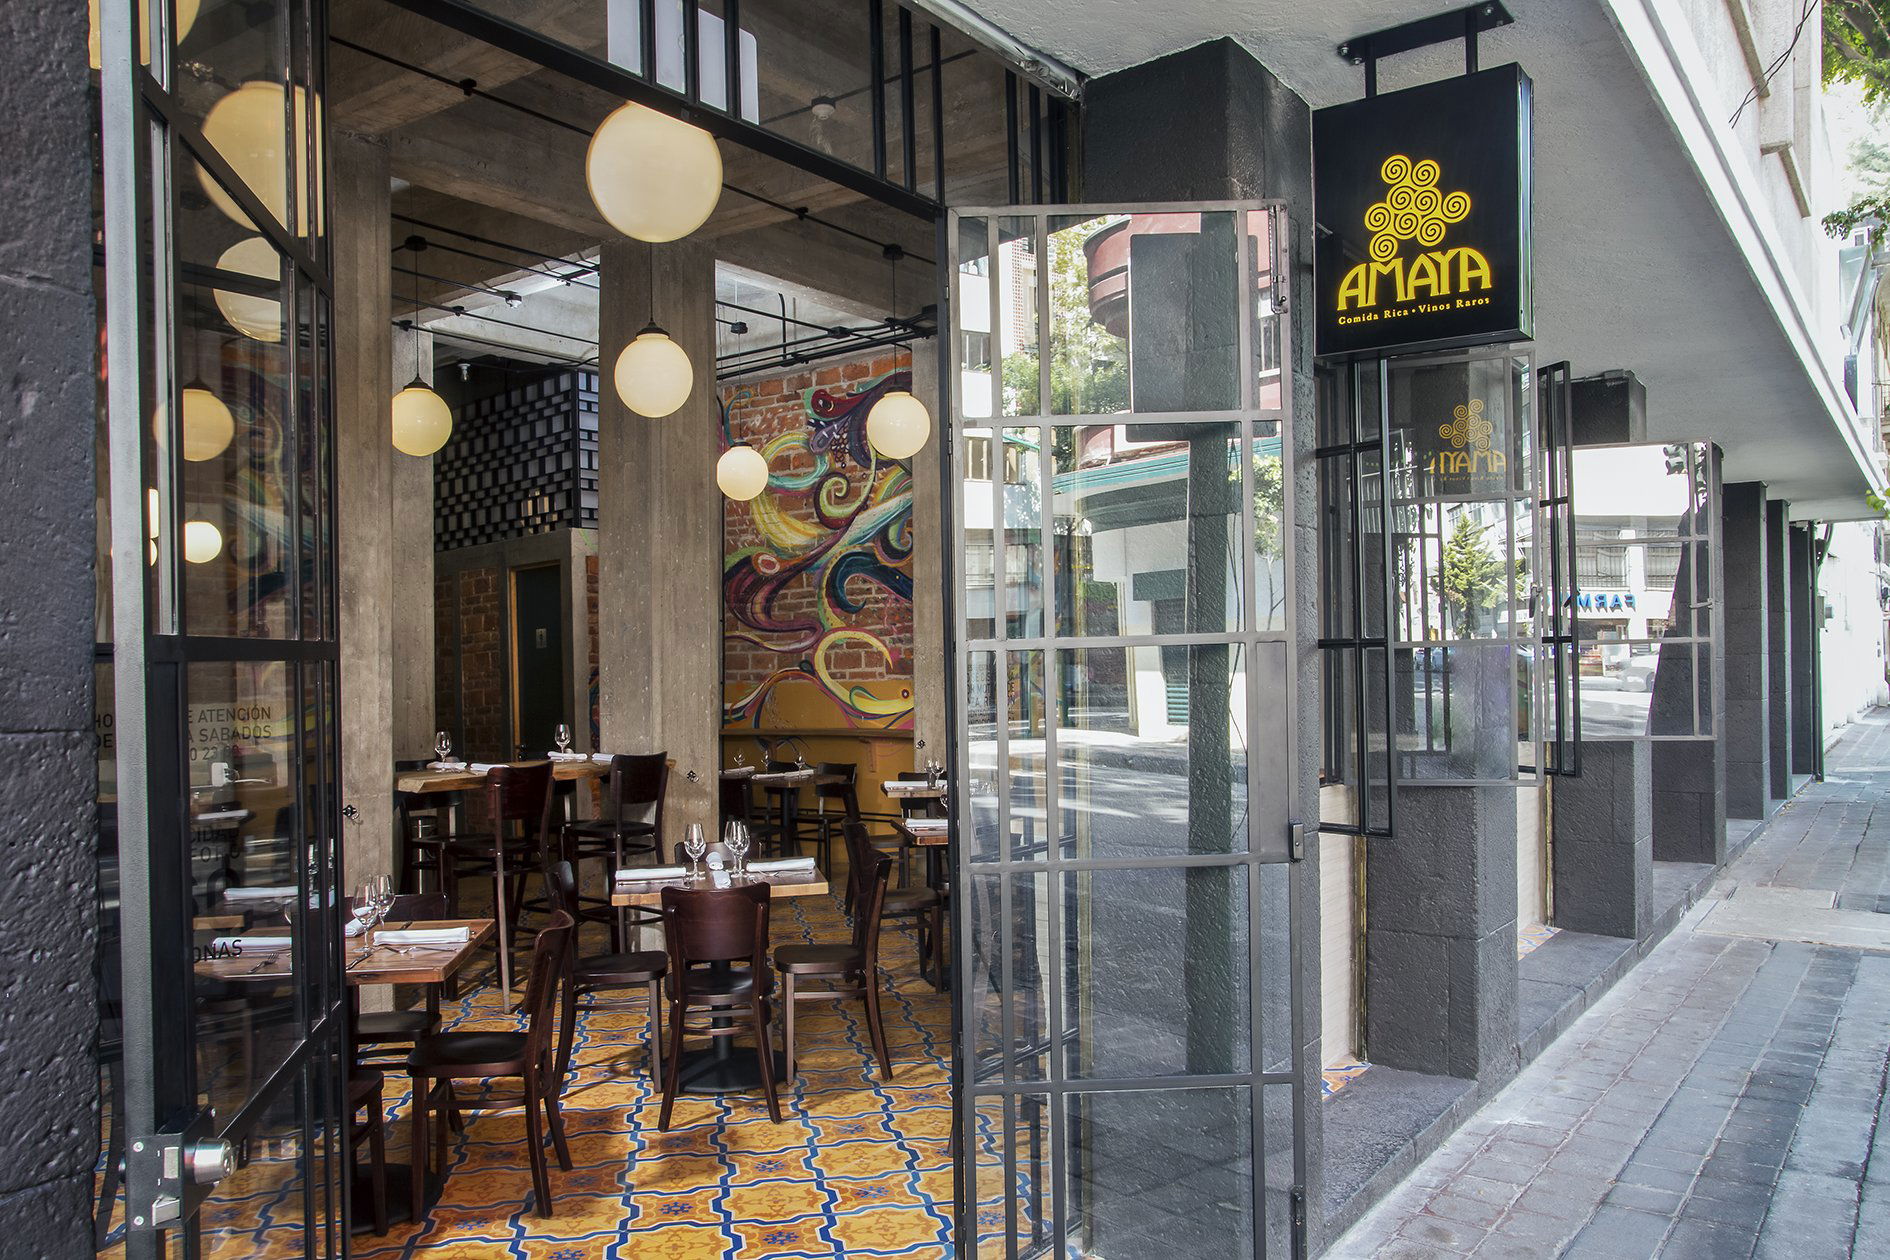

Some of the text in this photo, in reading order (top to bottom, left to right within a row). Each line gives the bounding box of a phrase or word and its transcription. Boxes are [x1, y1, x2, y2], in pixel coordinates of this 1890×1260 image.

[1337, 247, 1493, 311] AMAYA
[1338, 296, 1490, 325] Comida Rica Vinos Raros
[198, 704, 271, 723] ATENCIÓN
[199, 725, 272, 742] SABADOS
[193, 939, 243, 964] ONAS
